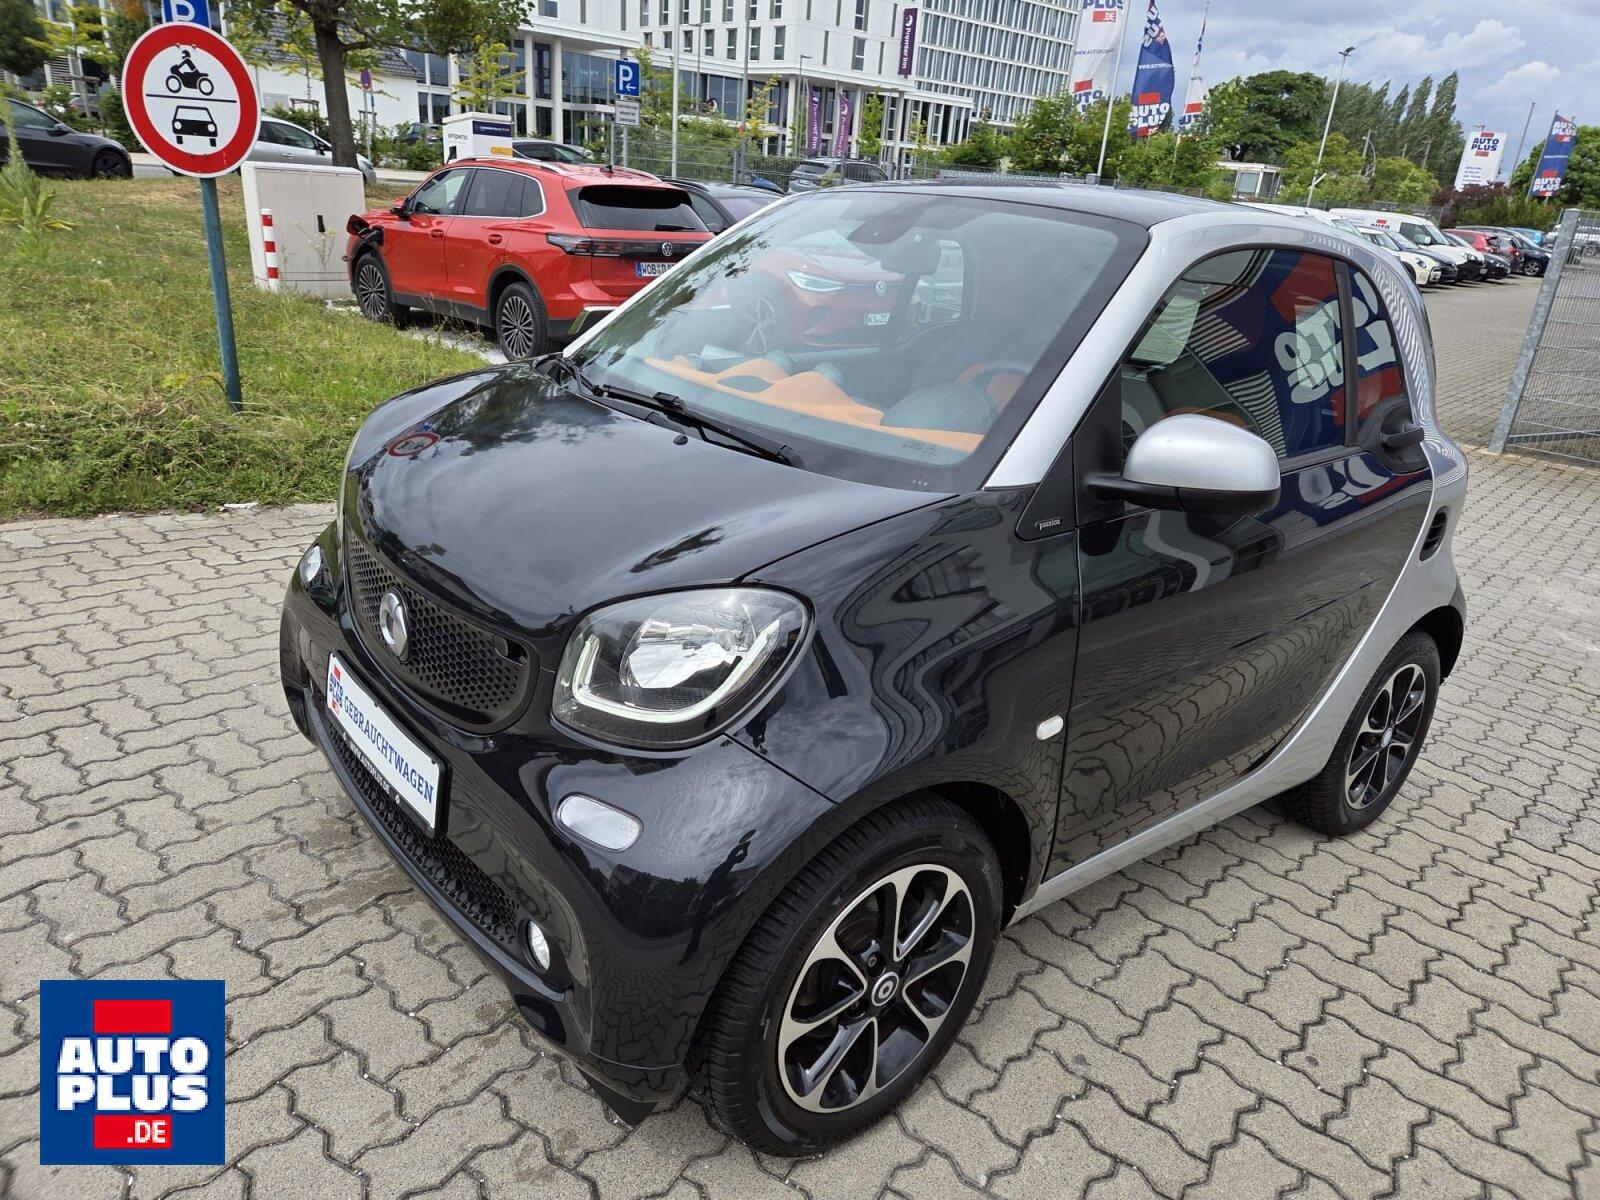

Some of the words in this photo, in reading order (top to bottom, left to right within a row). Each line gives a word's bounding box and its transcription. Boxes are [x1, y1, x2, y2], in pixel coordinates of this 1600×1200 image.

[619, 65, 633, 90] P
[1473, 137, 1499, 145] AUTO
[344, 695, 434, 804] GEBRAUCHTWAGEN
